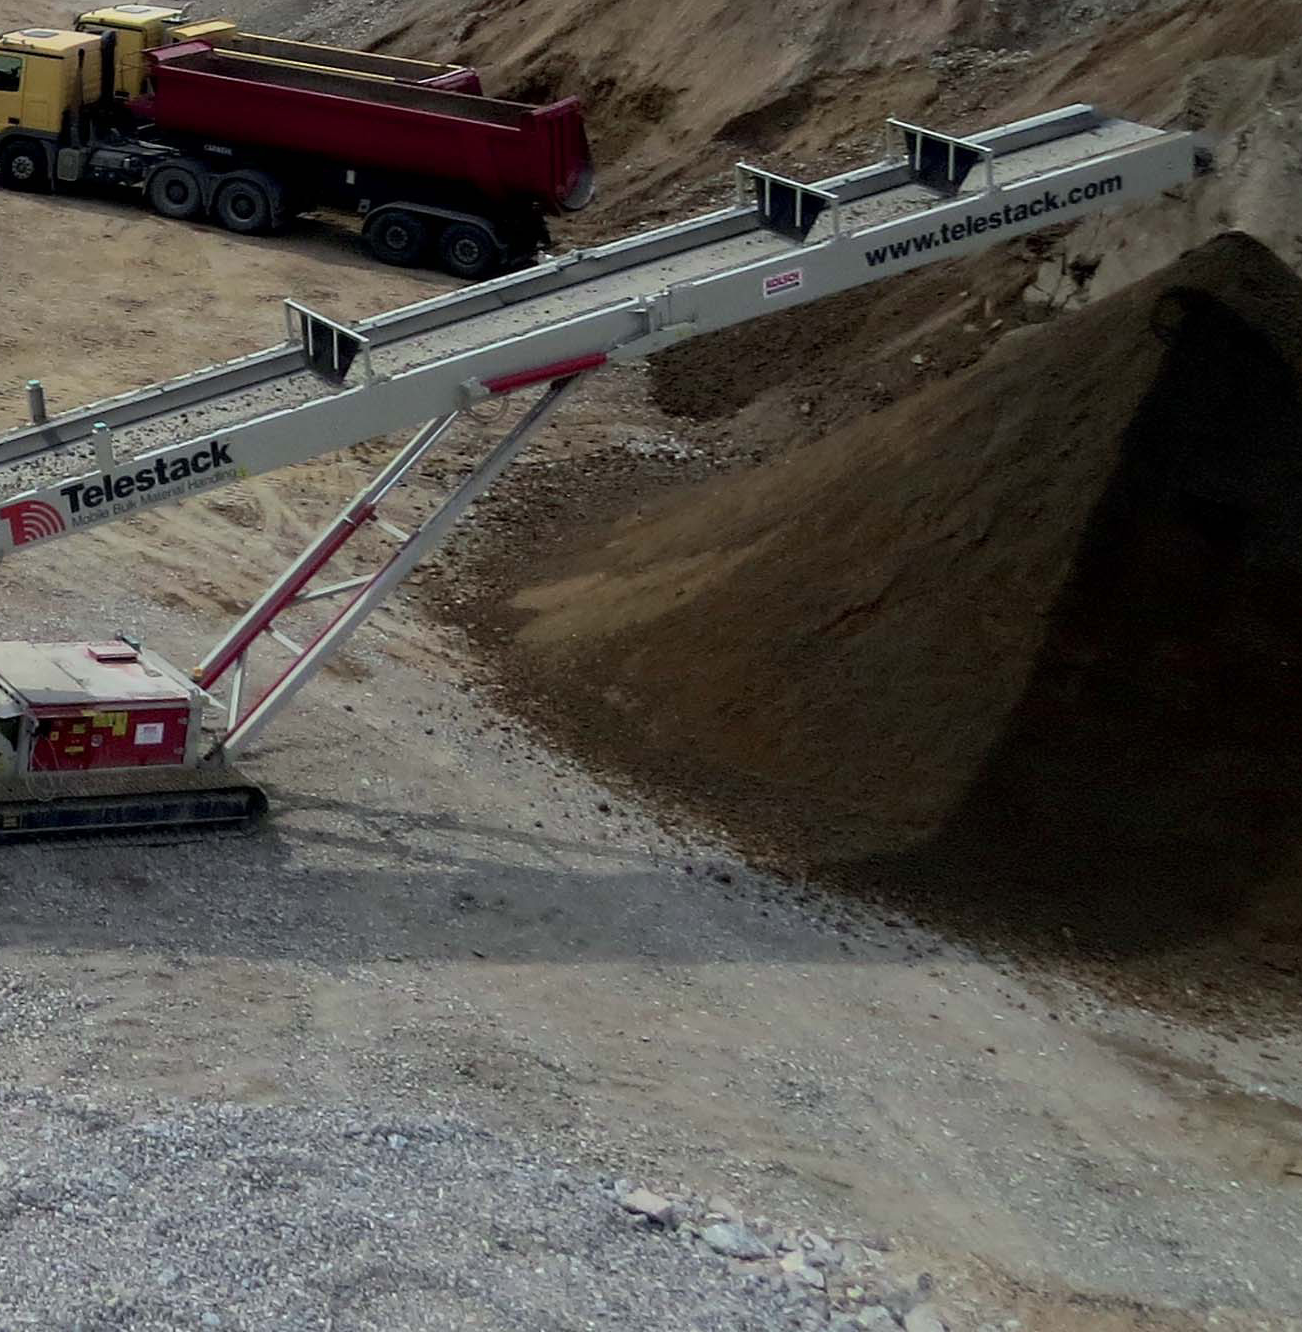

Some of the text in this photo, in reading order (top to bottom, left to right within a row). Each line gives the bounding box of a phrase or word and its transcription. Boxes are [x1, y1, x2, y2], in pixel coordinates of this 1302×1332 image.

[865, 175, 1123, 266] www.telestack.com
[61, 441, 233, 513] Telestack
[72, 506, 109, 529] Mobile
[113, 499, 137, 516] Bulk
[140, 483, 186, 506] Material
